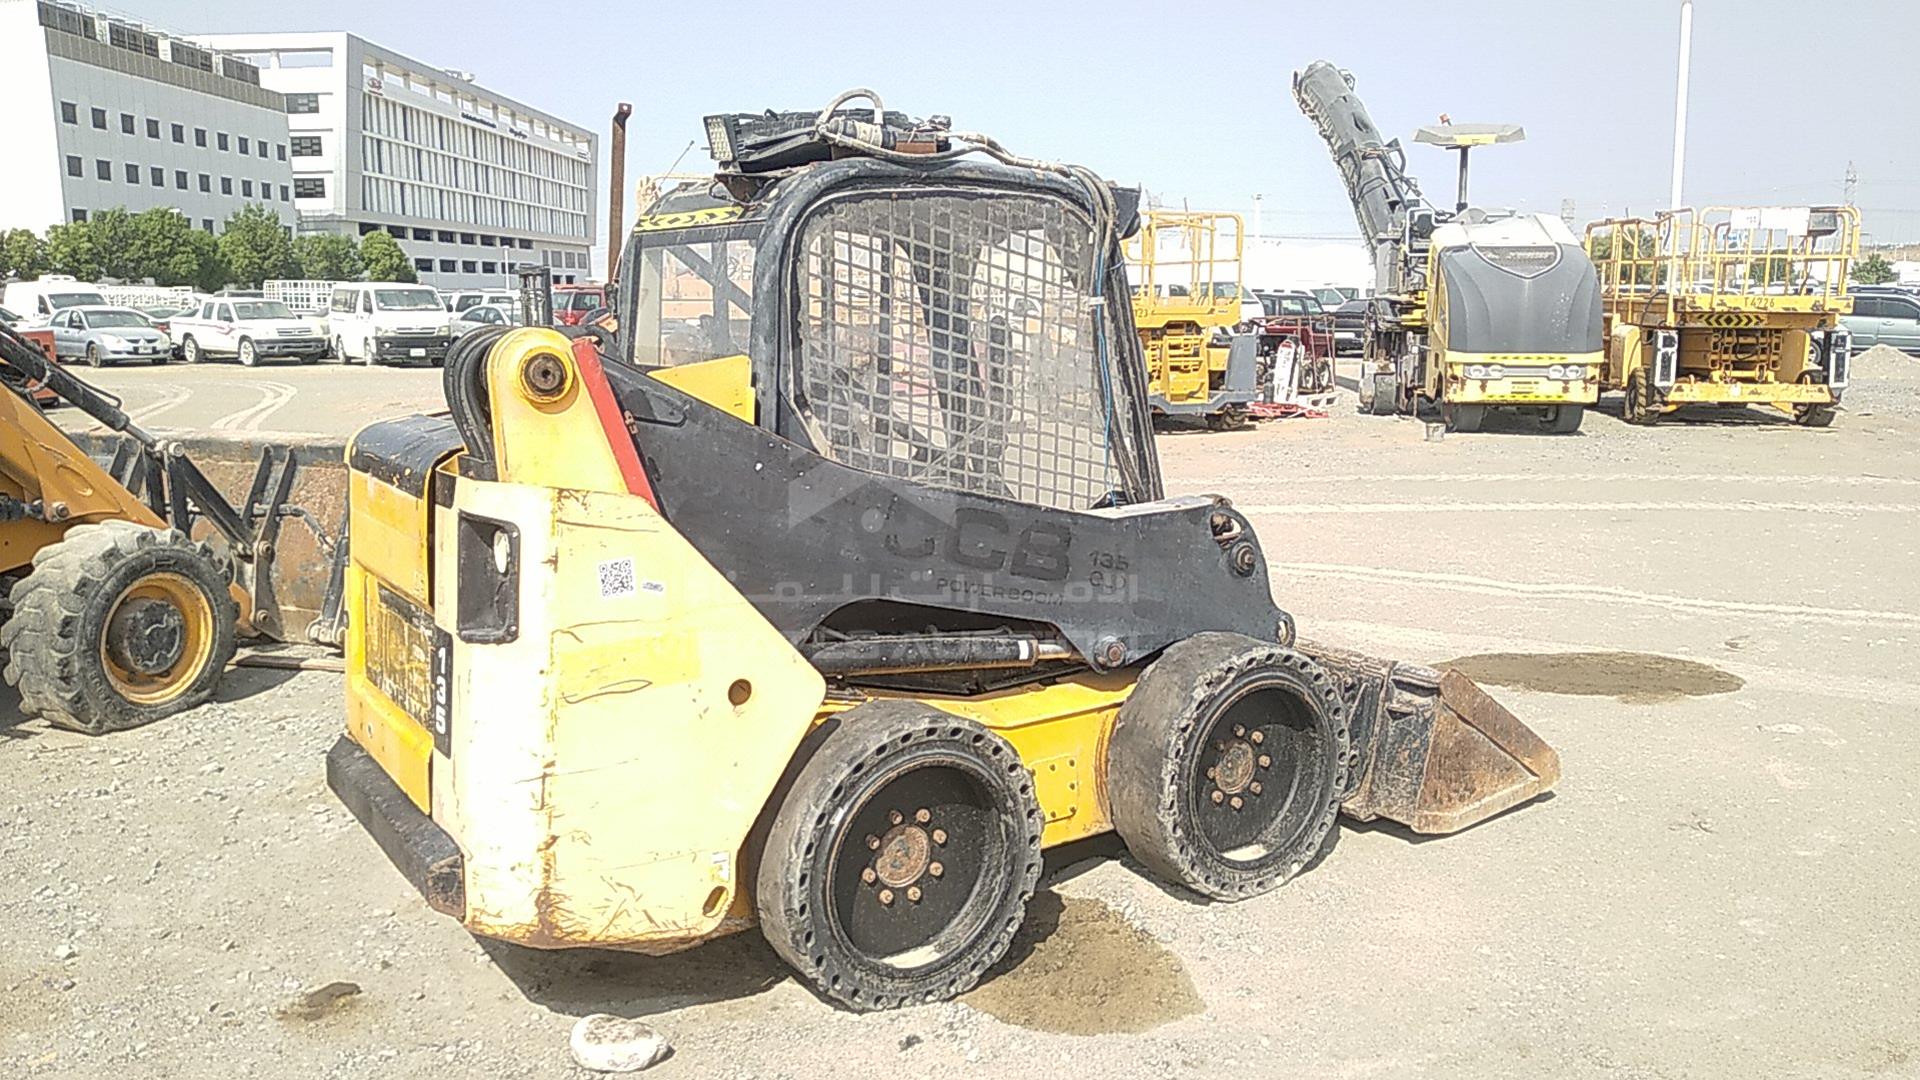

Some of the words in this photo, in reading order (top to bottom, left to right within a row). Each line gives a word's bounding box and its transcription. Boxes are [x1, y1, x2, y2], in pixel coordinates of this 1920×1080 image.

[1089, 549, 1129, 571] 135
[935, 576, 1065, 607] POWERBOOM
[435, 647, 446, 735] 135
